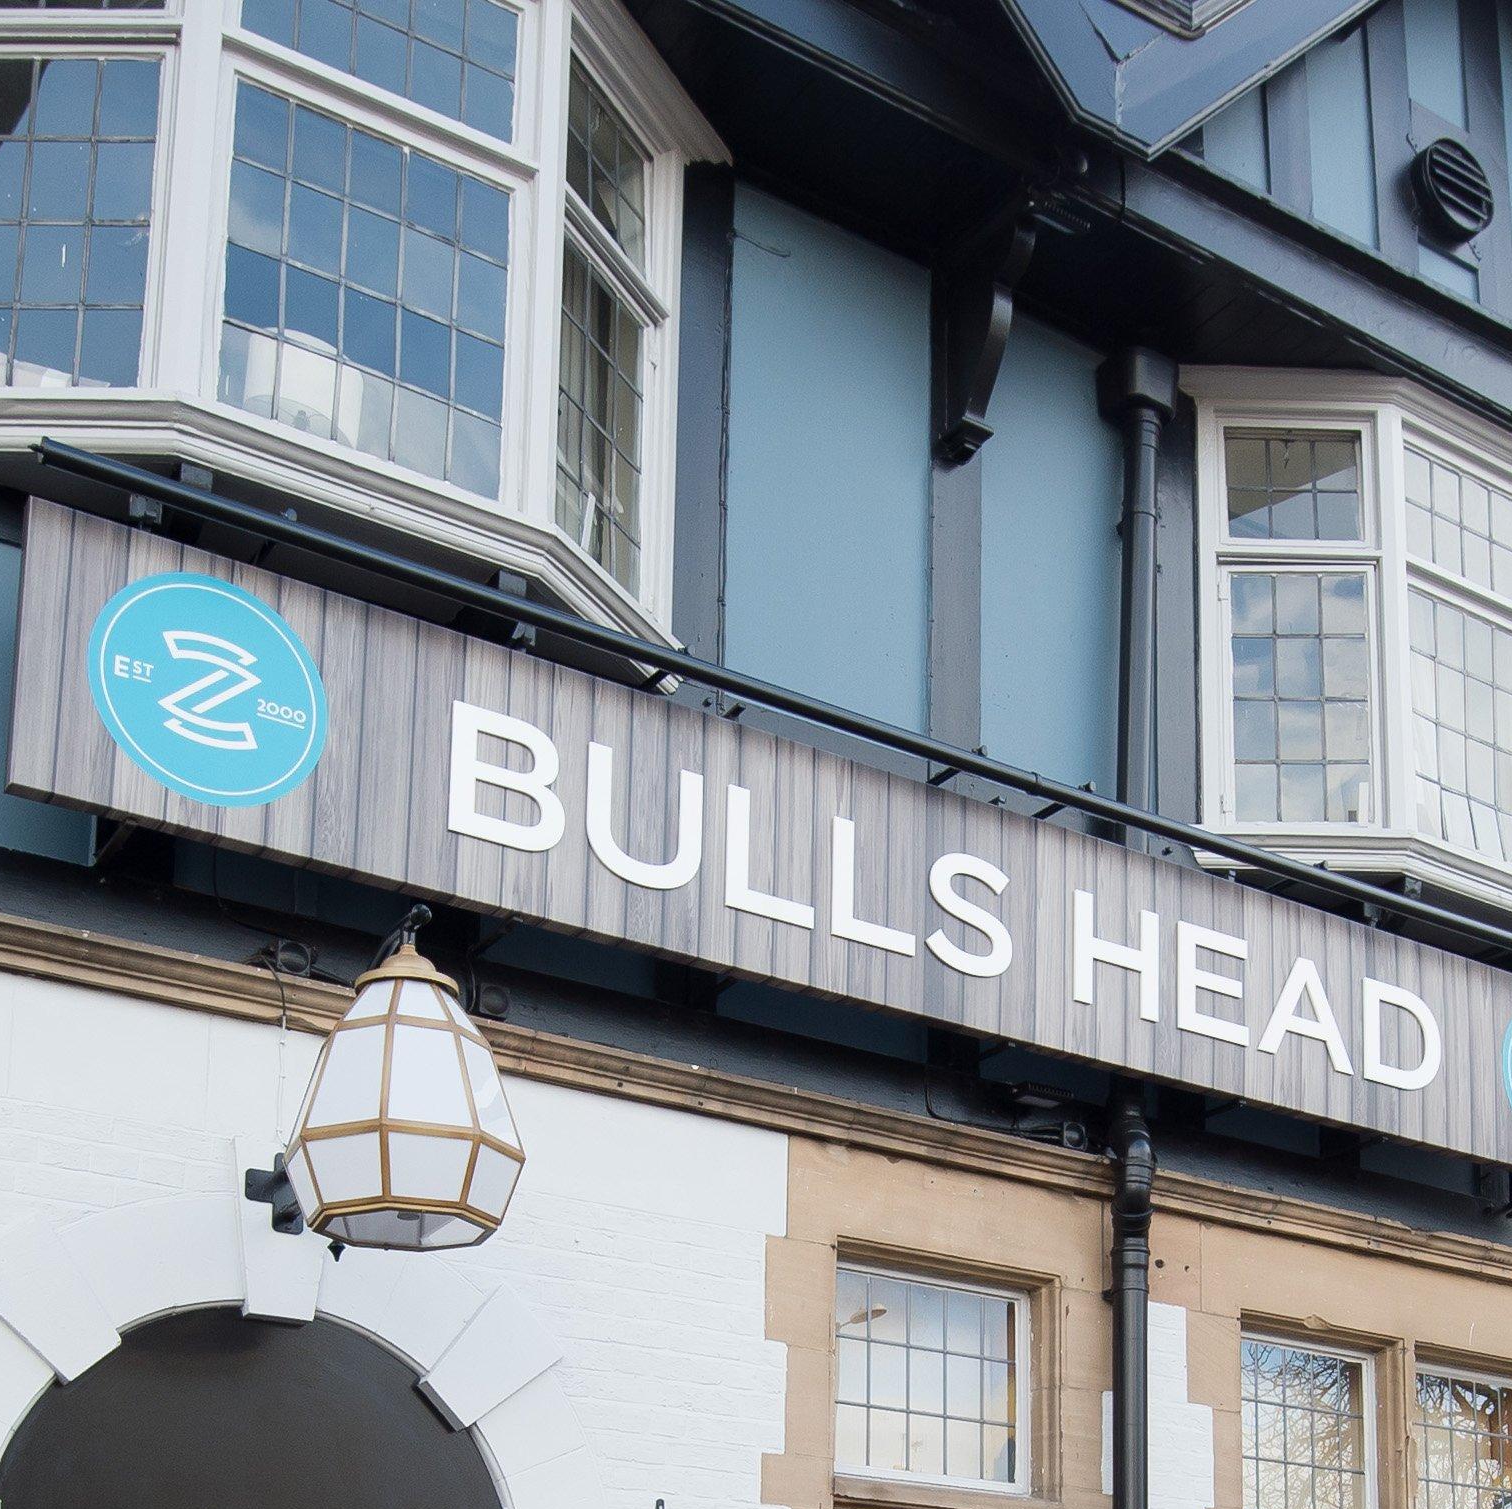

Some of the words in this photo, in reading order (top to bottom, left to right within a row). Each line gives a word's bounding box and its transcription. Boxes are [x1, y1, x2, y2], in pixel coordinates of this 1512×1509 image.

[256, 698, 307, 726] 2000
[447, 699, 1014, 979] BULLS
[1072, 888, 1443, 1092] HEAD
